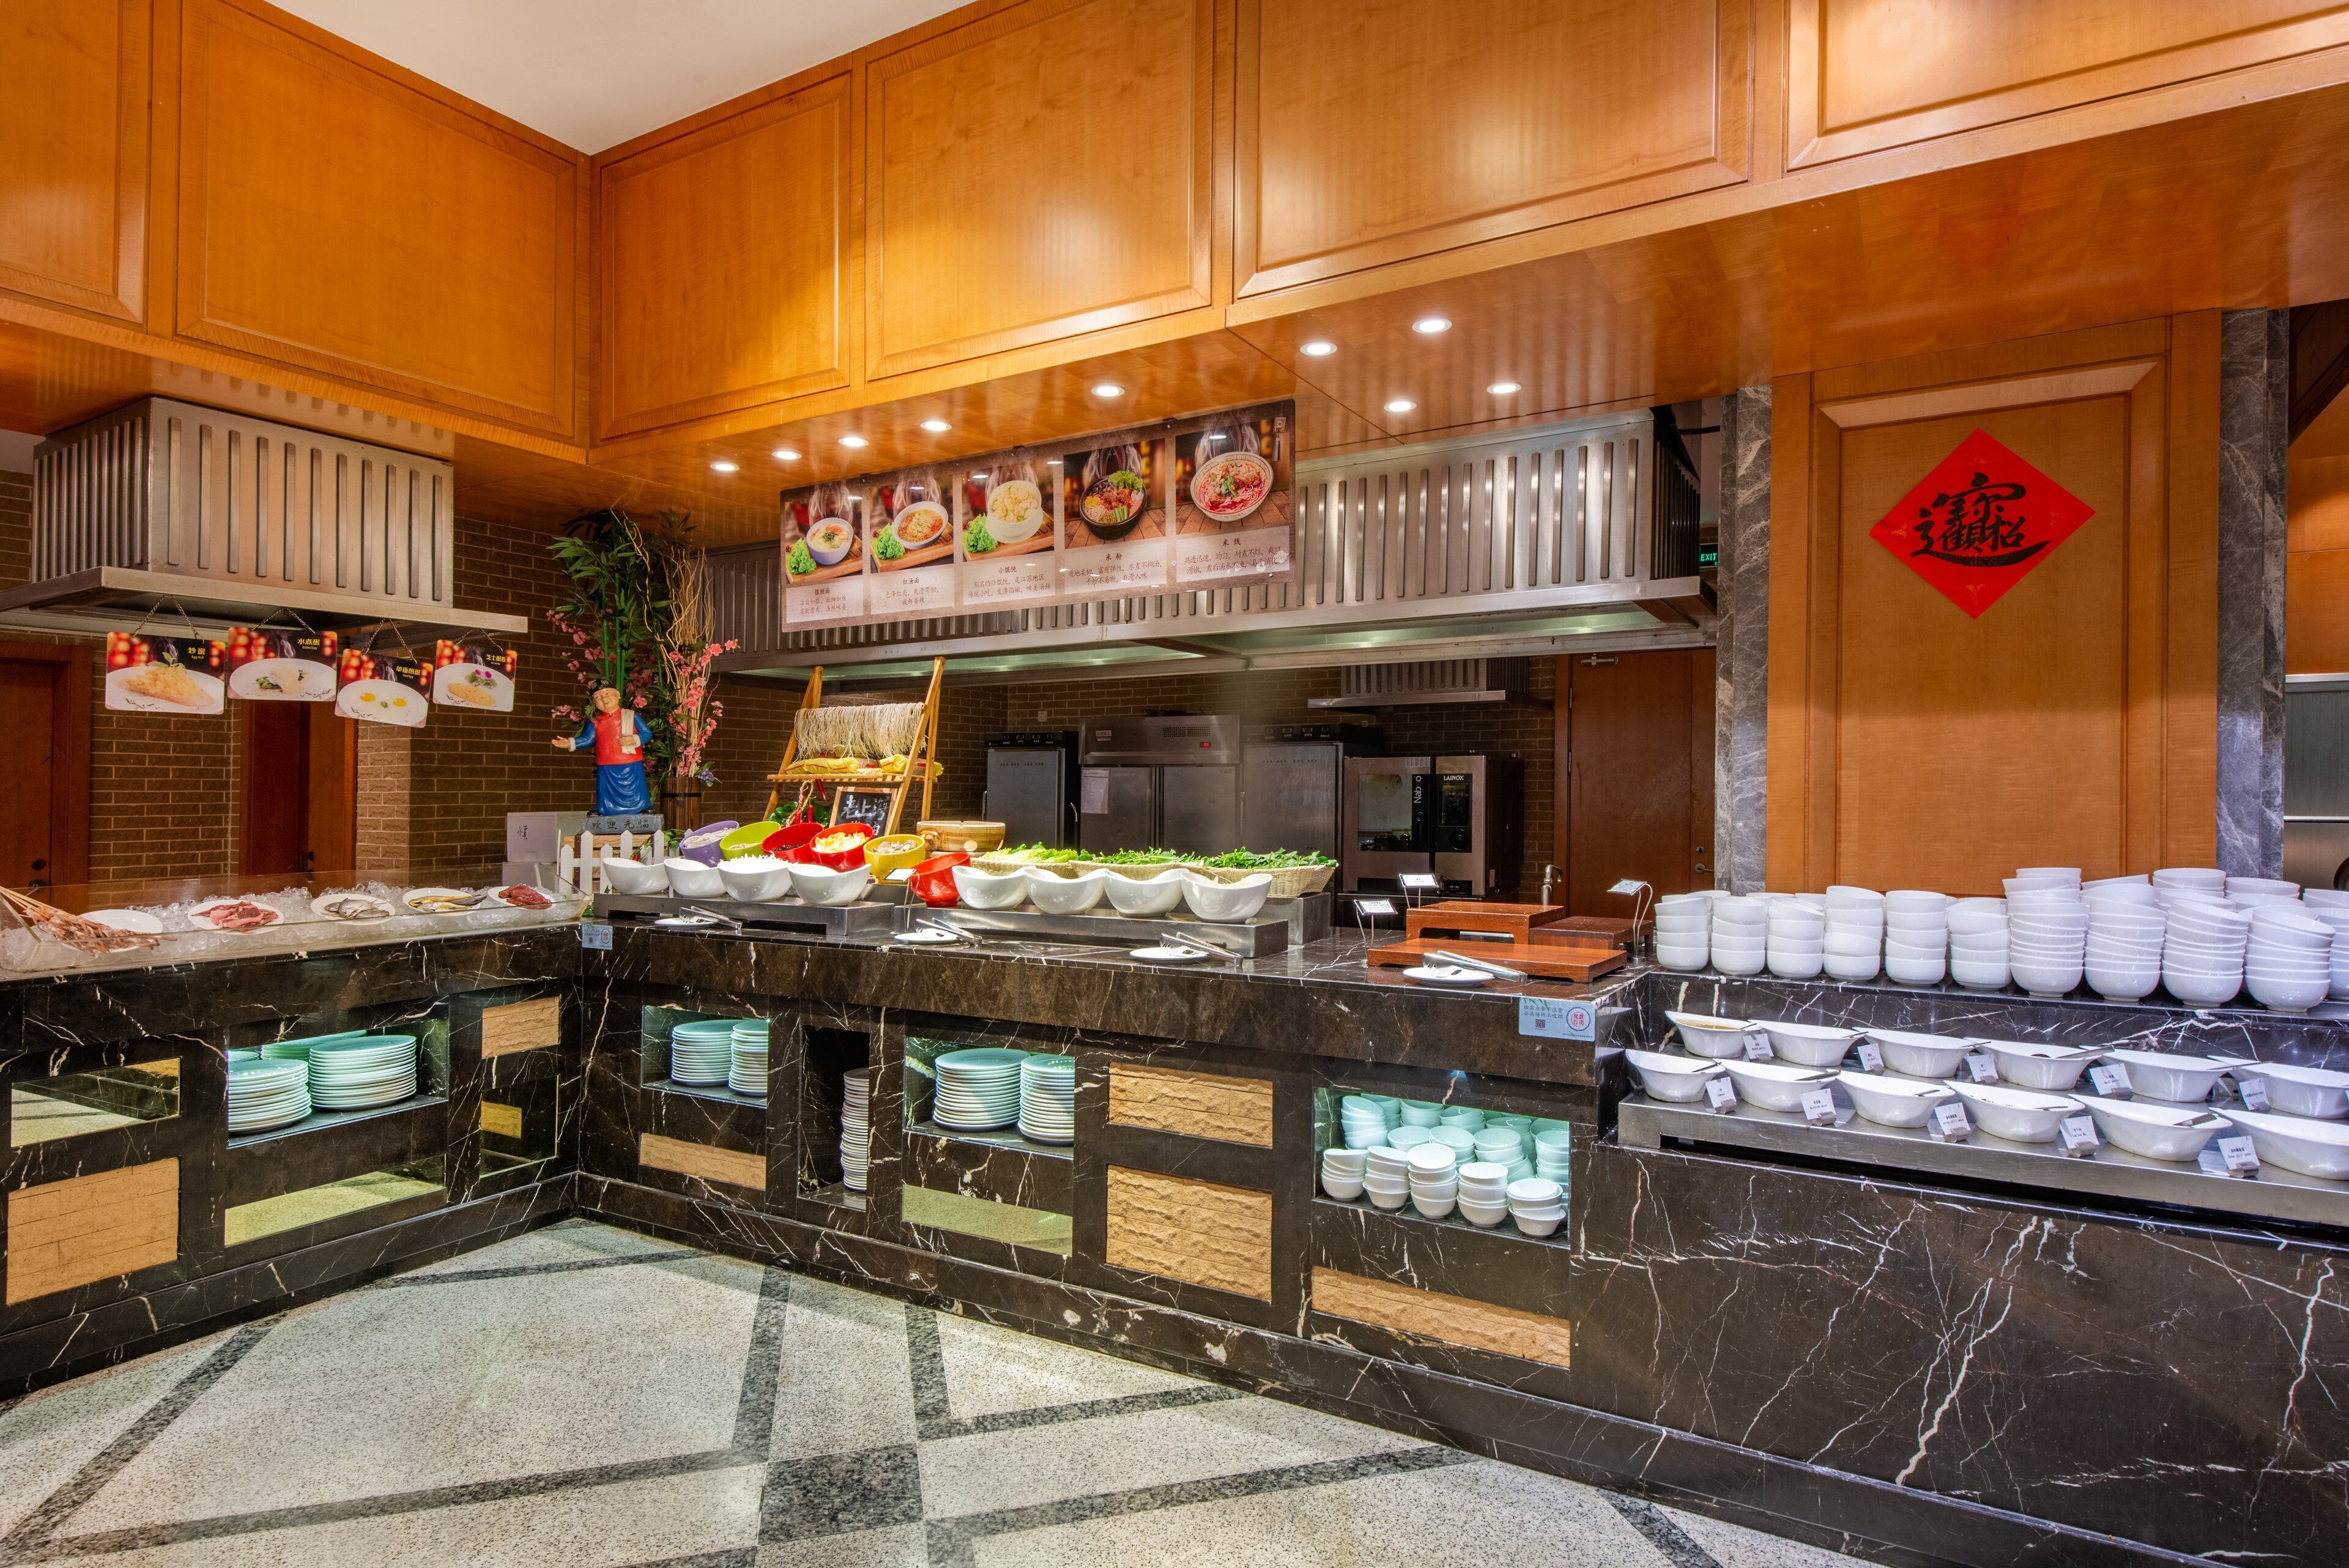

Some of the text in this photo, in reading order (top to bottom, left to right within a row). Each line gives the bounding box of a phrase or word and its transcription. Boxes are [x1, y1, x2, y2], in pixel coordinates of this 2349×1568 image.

[998, 565, 1017, 574] 小馄饨
[188, 647, 206, 655] 炒蛋
[486, 654, 506, 663] 芝士蛋卷
[396, 666, 421, 676] 单面煎蛋
[592, 819, 649, 830] 欢迎光临
